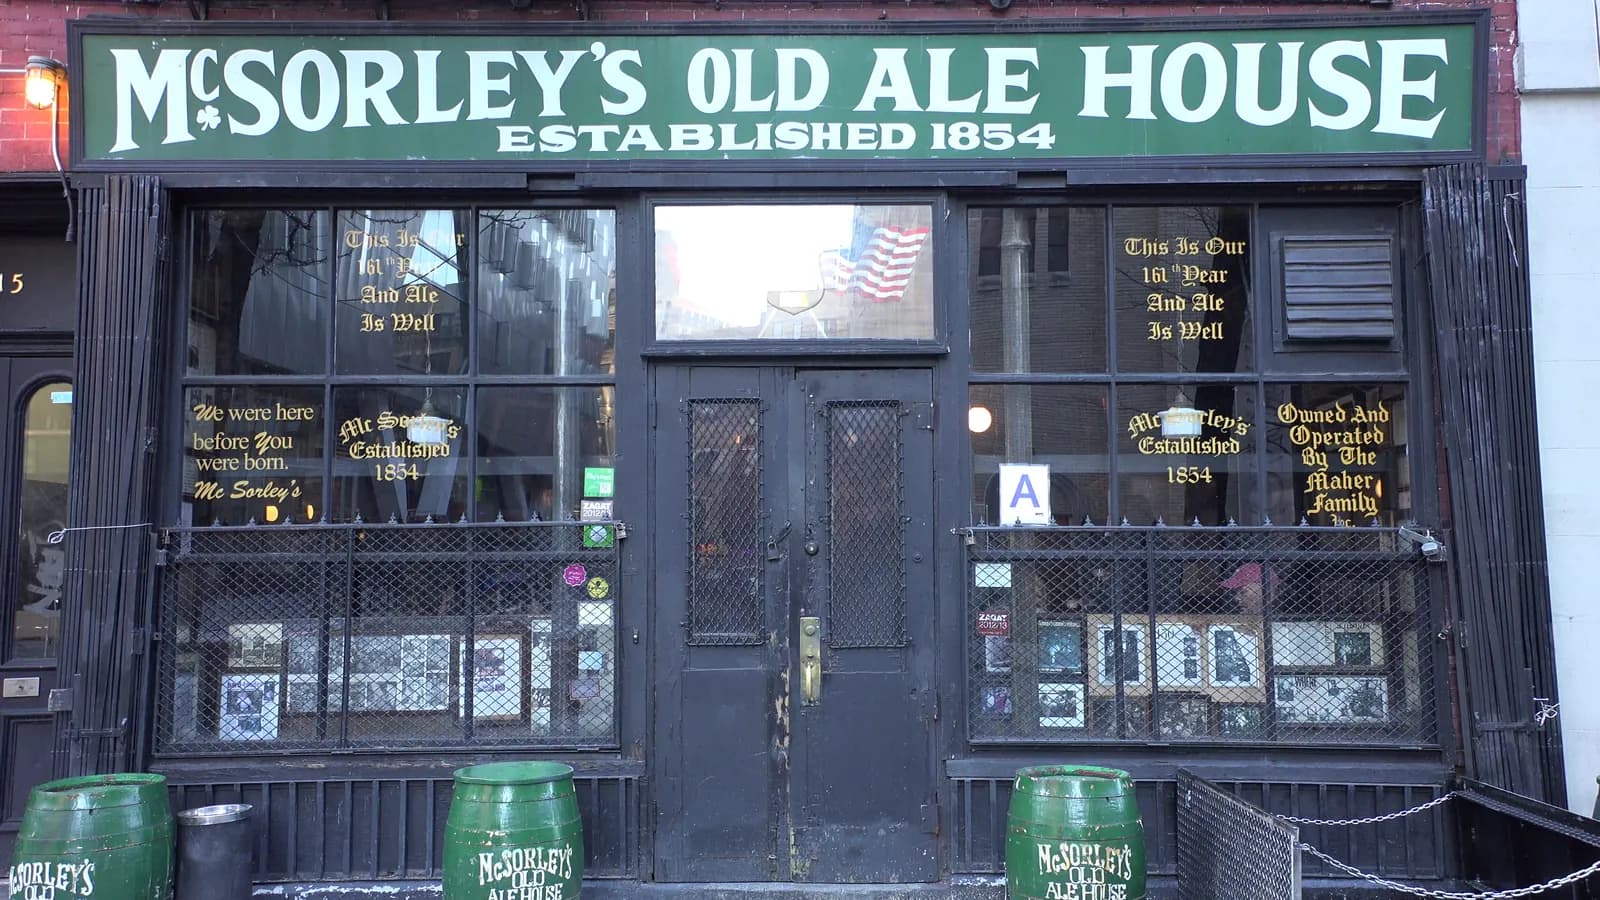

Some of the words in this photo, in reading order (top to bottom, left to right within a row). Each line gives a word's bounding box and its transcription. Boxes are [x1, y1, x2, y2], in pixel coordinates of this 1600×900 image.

[687, 48, 830, 114] OLD
[852, 47, 1041, 114] ALE
[1077, 38, 1449, 139] HOUSE
[496, 123, 917, 152] ESTABLISHED
[930, 121, 1056, 150] 1854
[395, 229, 420, 248] Is
[1123, 236, 1169, 259] This
[1174, 236, 1200, 256] Is
[1204, 236, 1246, 255] Our
[1181, 265, 1228, 287] Year
[360, 286, 399, 304] And
[404, 286, 439, 304] Ale
[1146, 293, 1186, 312] And
[1191, 293, 1225, 312] Ale
[360, 313, 385, 332] Is
[390, 313, 436, 332] Well
[1147, 321, 1173, 341] Is
[1177, 321, 1224, 340] Well
[193, 404, 224, 421] We
[228, 408, 272, 420] were
[275, 403, 314, 420] here
[1277, 402, 1346, 424] Owned
[1350, 401, 1390, 423] And
[339, 417, 374, 444] Mc
[1127, 412, 1161, 440] Mc
[193, 432, 249, 450] before
[254, 431, 293, 455] You
[1289, 424, 1384, 449] Operated
[349, 441, 450, 461] Established
[1138, 437, 1240, 457] Established
[196, 457, 240, 471] were
[244, 453, 289, 471] born.
[1301, 446, 1329, 472] By
[1338, 446, 1377, 465] The
[375, 463, 419, 481] 1854
[1167, 466, 1213, 484] 1854
[1303, 470, 1374, 493] Maher
[194, 481, 225, 500] Mc
[230, 479, 303, 503] Sorley's
[1009, 474, 1041, 508] A
[1306, 492, 1379, 518] Family
[511, 869, 545, 889] OLD
[1069, 866, 1105, 884] OLD
[24, 885, 55, 900] OLD
[1045, 881, 1079, 900] ALE
[1080, 883, 1127, 900] HOUSE
